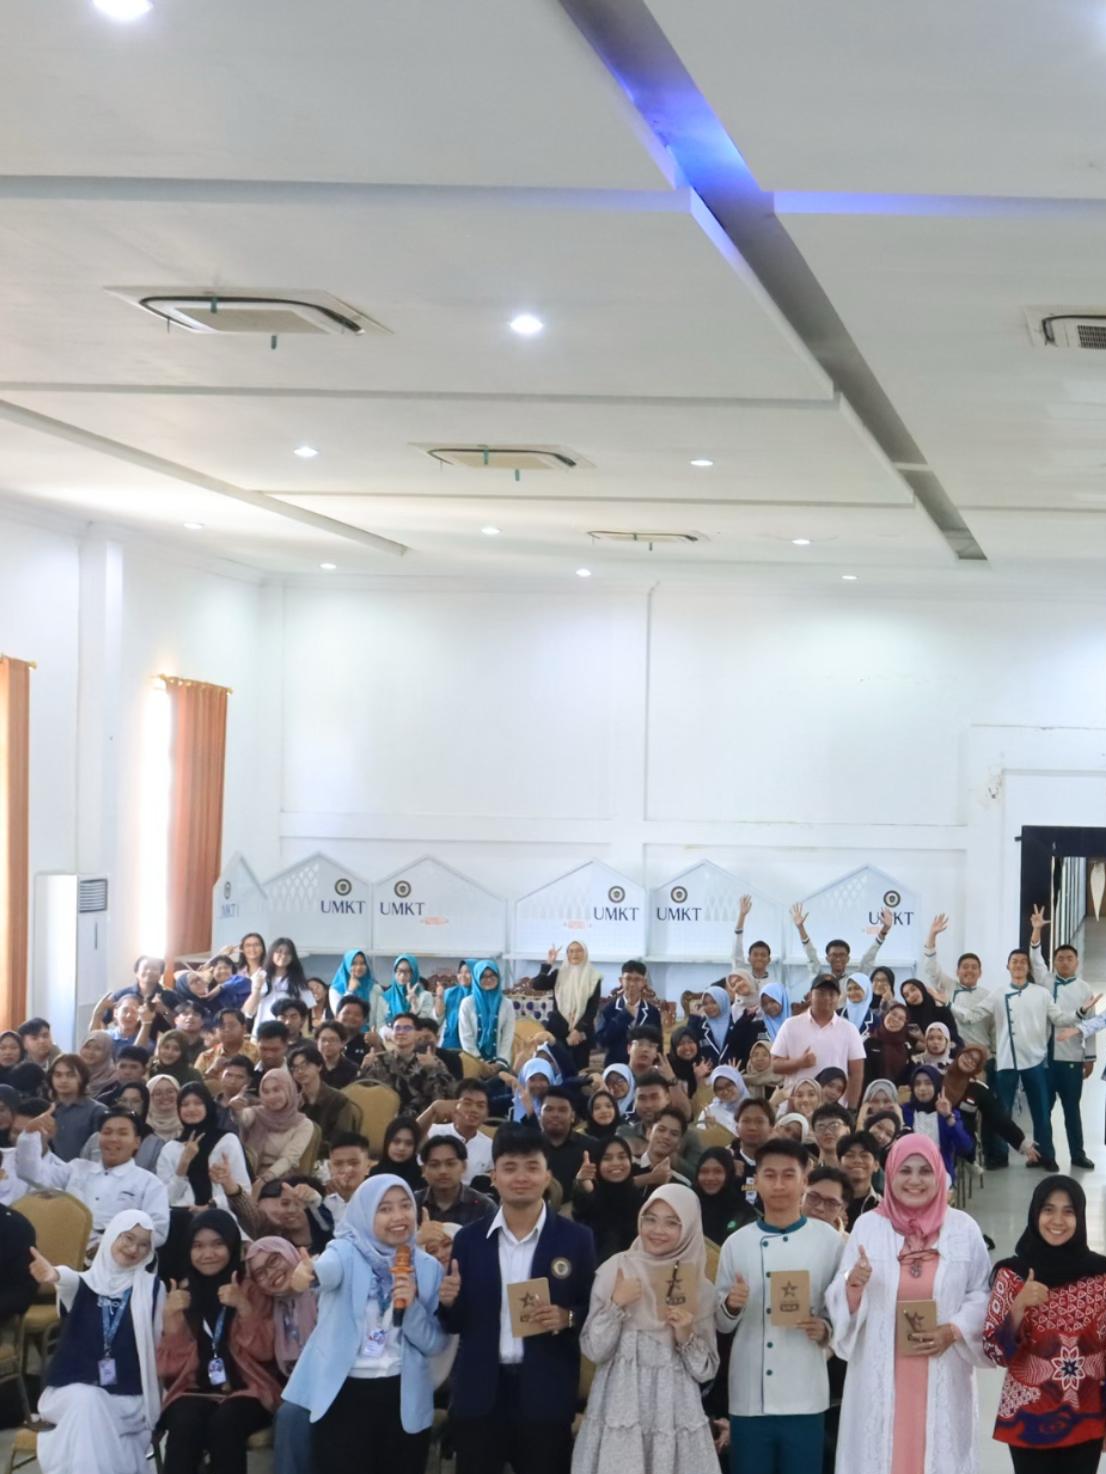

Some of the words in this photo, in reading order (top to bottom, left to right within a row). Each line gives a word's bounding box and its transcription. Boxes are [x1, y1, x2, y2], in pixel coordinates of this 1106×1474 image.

[320, 900, 366, 915] UMKT
[379, 901, 426, 916] UMKT
[593, 907, 640, 921] UMKT
[656, 907, 702, 921] UMKT
[868, 911, 914, 926] UKT
